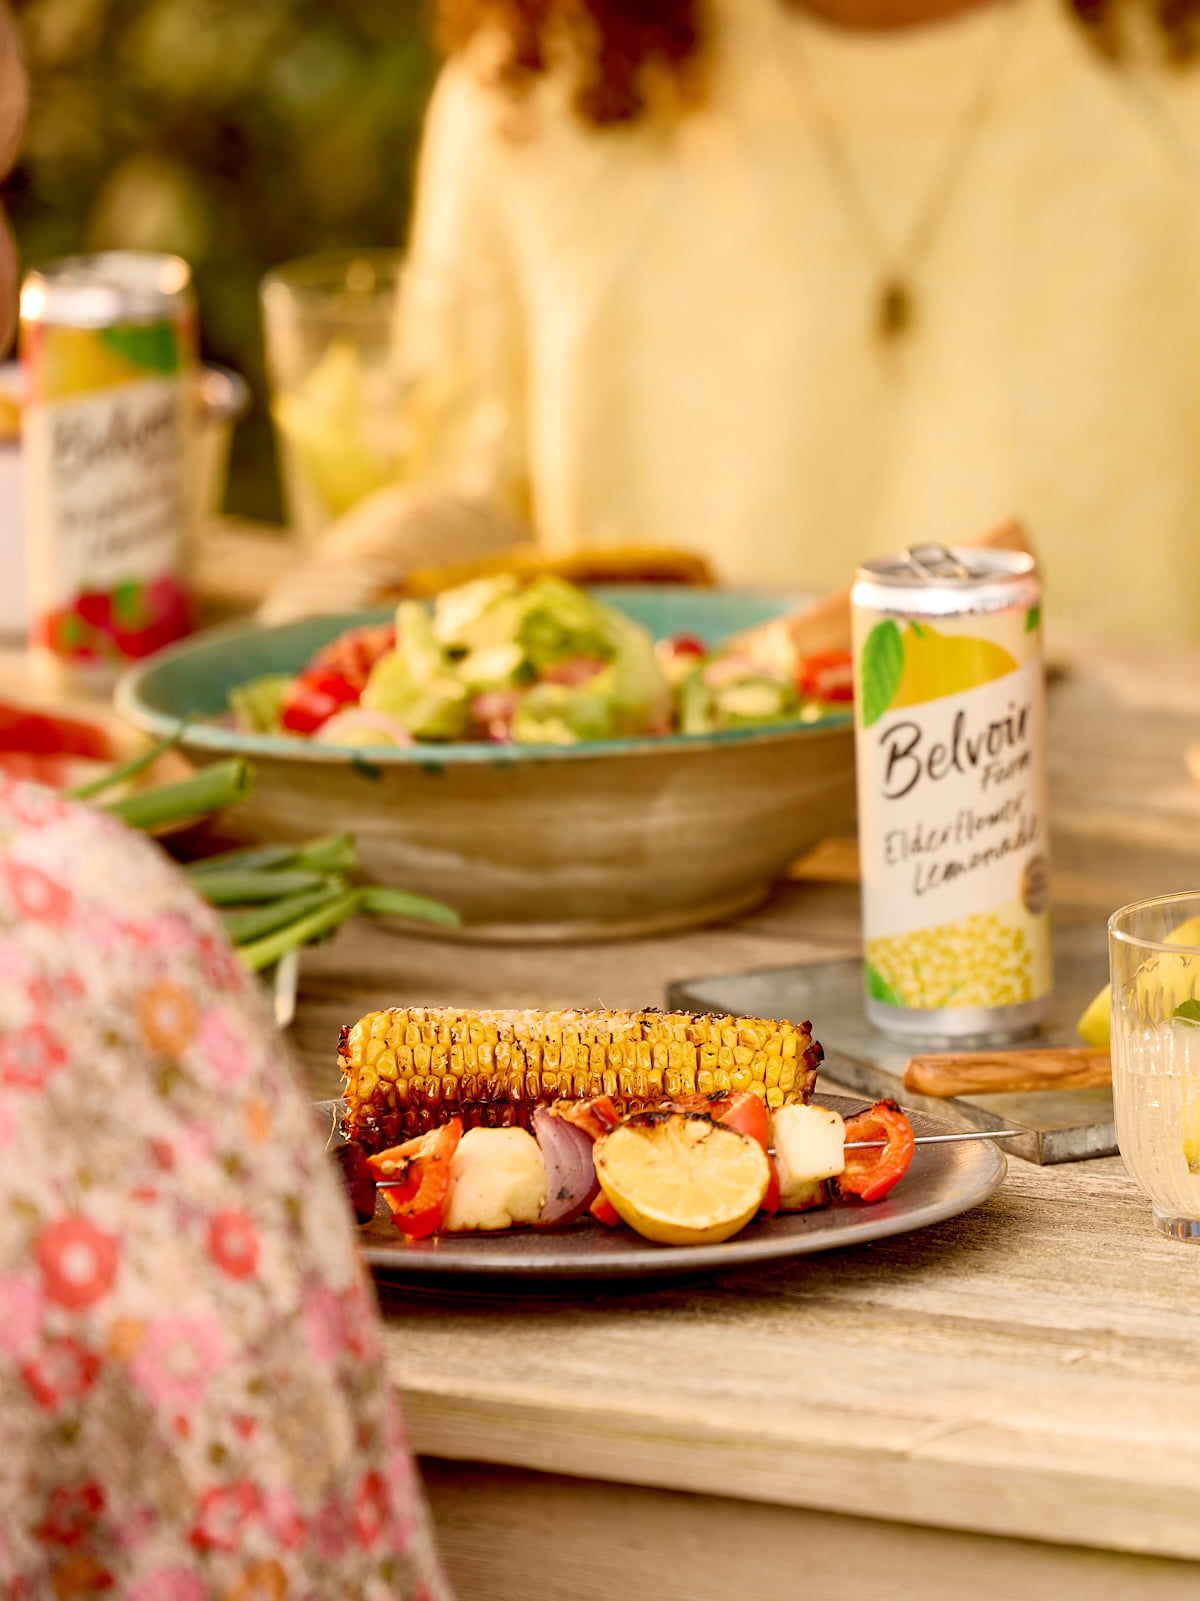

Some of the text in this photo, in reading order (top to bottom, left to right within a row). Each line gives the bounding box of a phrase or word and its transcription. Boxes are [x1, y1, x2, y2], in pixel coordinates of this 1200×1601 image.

[879, 701, 1031, 800] Belvoir
[884, 791, 1025, 867] Elderflower
[913, 813, 1040, 896] Lemonade
